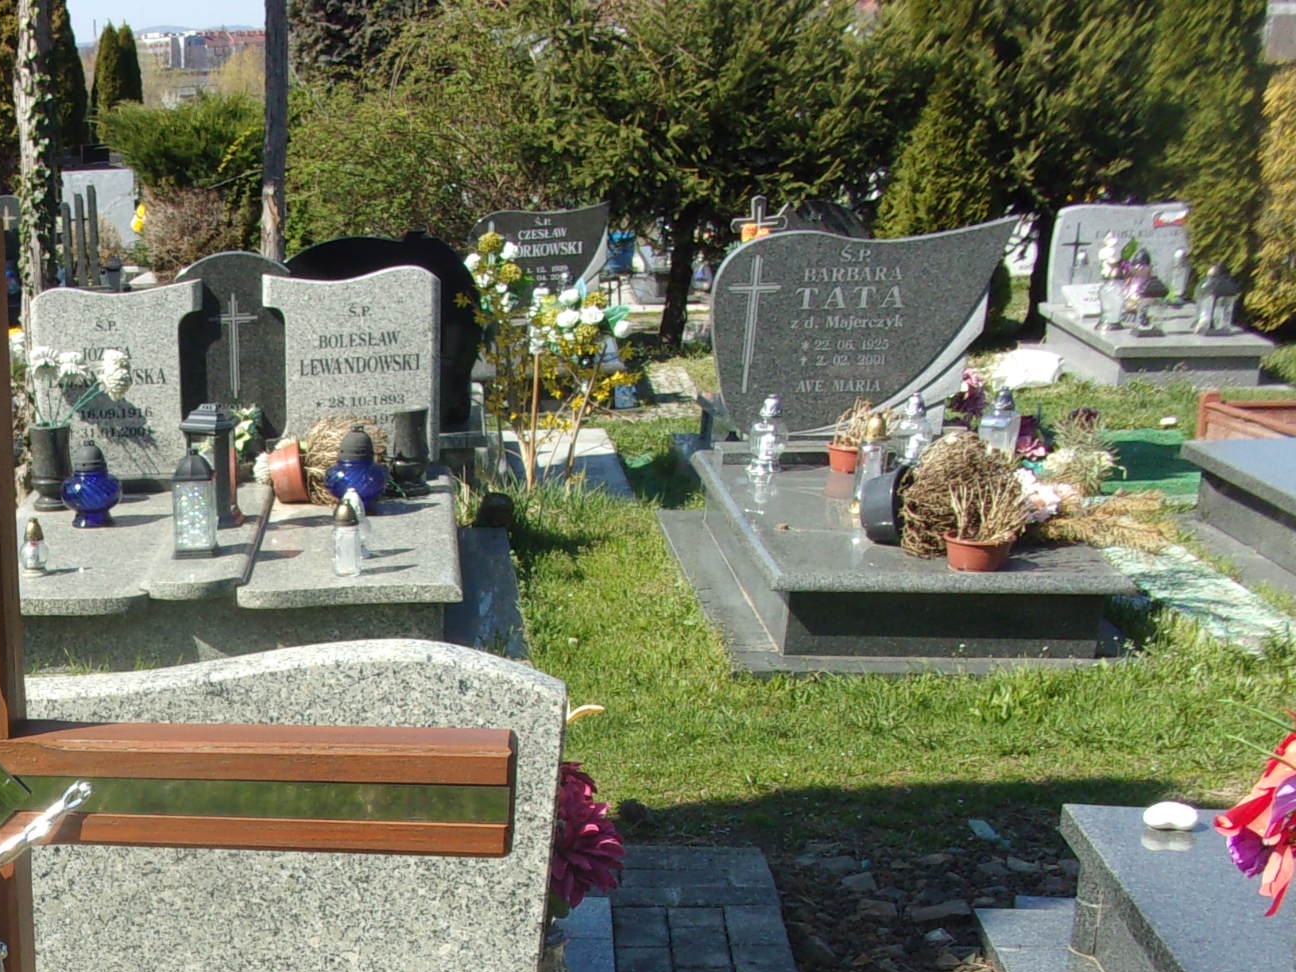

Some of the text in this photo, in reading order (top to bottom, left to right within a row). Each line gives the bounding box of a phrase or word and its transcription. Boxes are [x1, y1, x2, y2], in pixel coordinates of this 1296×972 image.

[517, 227, 568, 240] CZESŁAW
[517, 241, 584, 257] ÓRKOWSKI
[804, 266, 904, 282] BARBARA
[795, 285, 906, 310] TATA
[790, 319, 800, 329] z
[825, 314, 904, 331] Majerczyk
[319, 330, 402, 349] BOLESŁAW
[300, 353, 421, 376] LEWANDOWSKI
[795, 379, 881, 392] AVE MARIA
